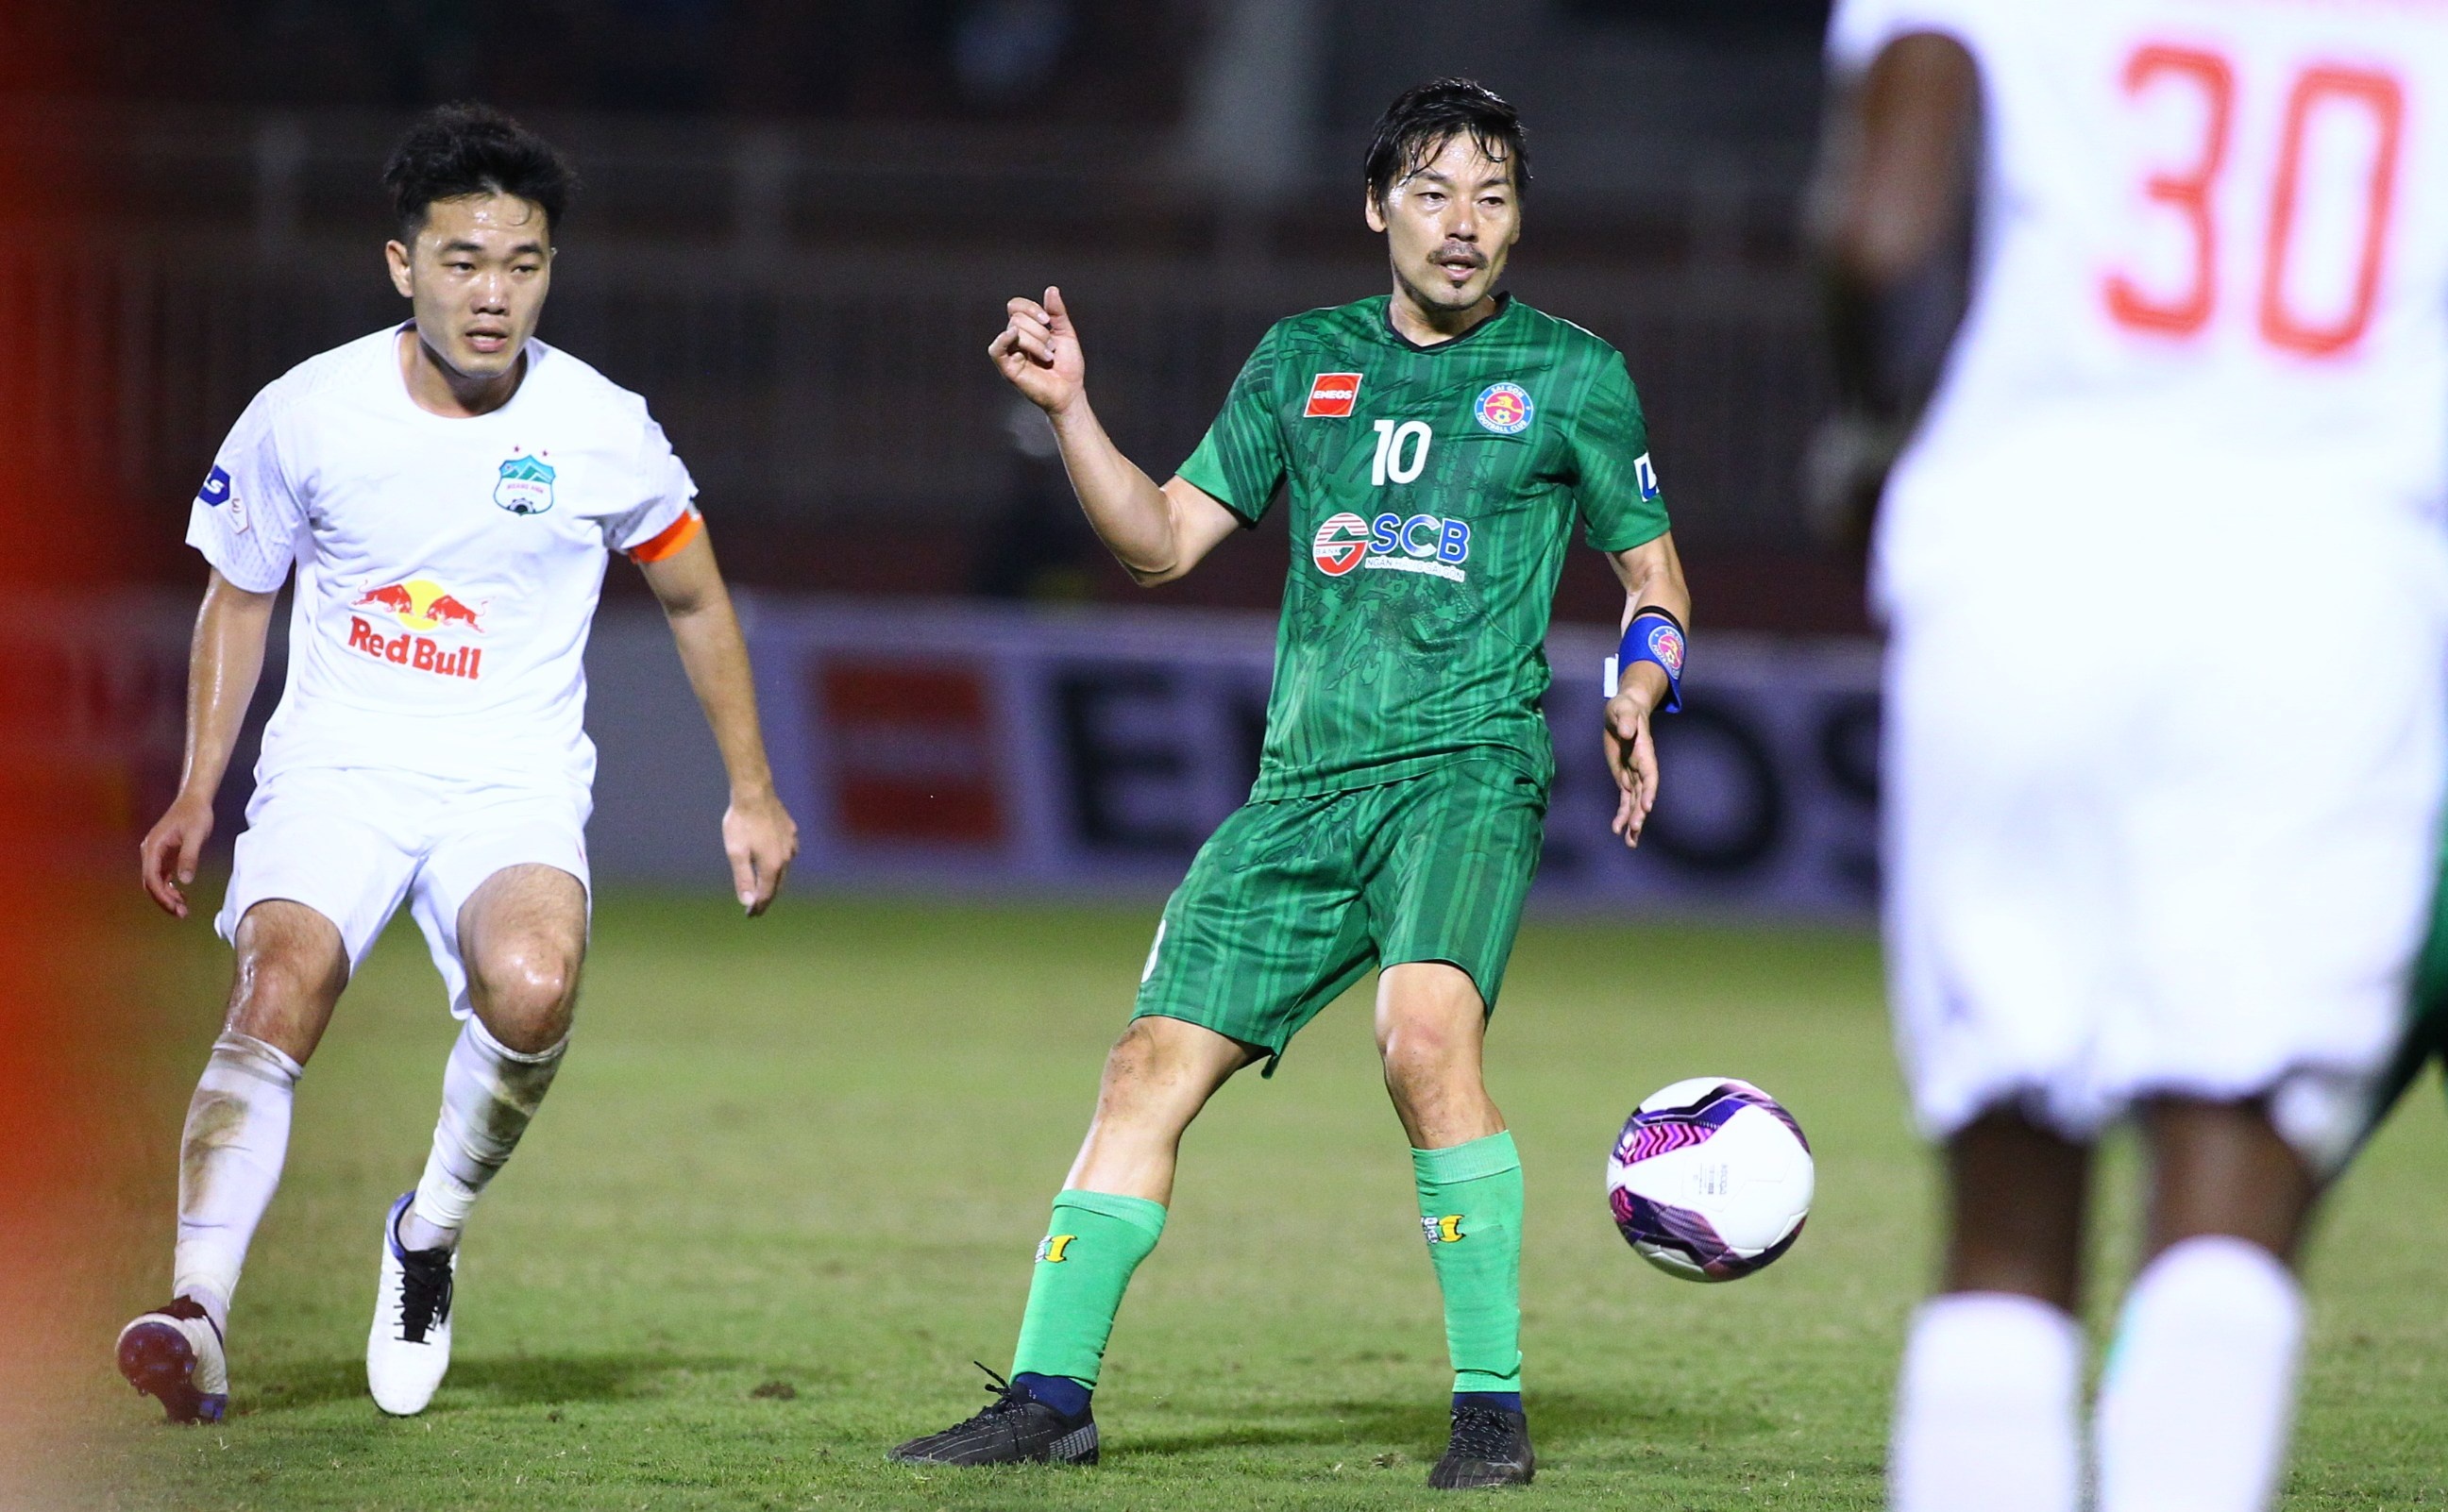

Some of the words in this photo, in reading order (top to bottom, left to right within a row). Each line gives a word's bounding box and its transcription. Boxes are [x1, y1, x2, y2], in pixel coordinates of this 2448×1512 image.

[2101, 42, 2405, 357] 30
[1312, 389, 1353, 400] ENEOS
[1477, 412, 1509, 432] FOOTBALL
[1372, 419, 1432, 486] 10
[1315, 547, 1340, 556] BANK
[1369, 512, 1471, 564] SCB
[347, 615, 411, 664] Red
[413, 637, 481, 680] Bull
